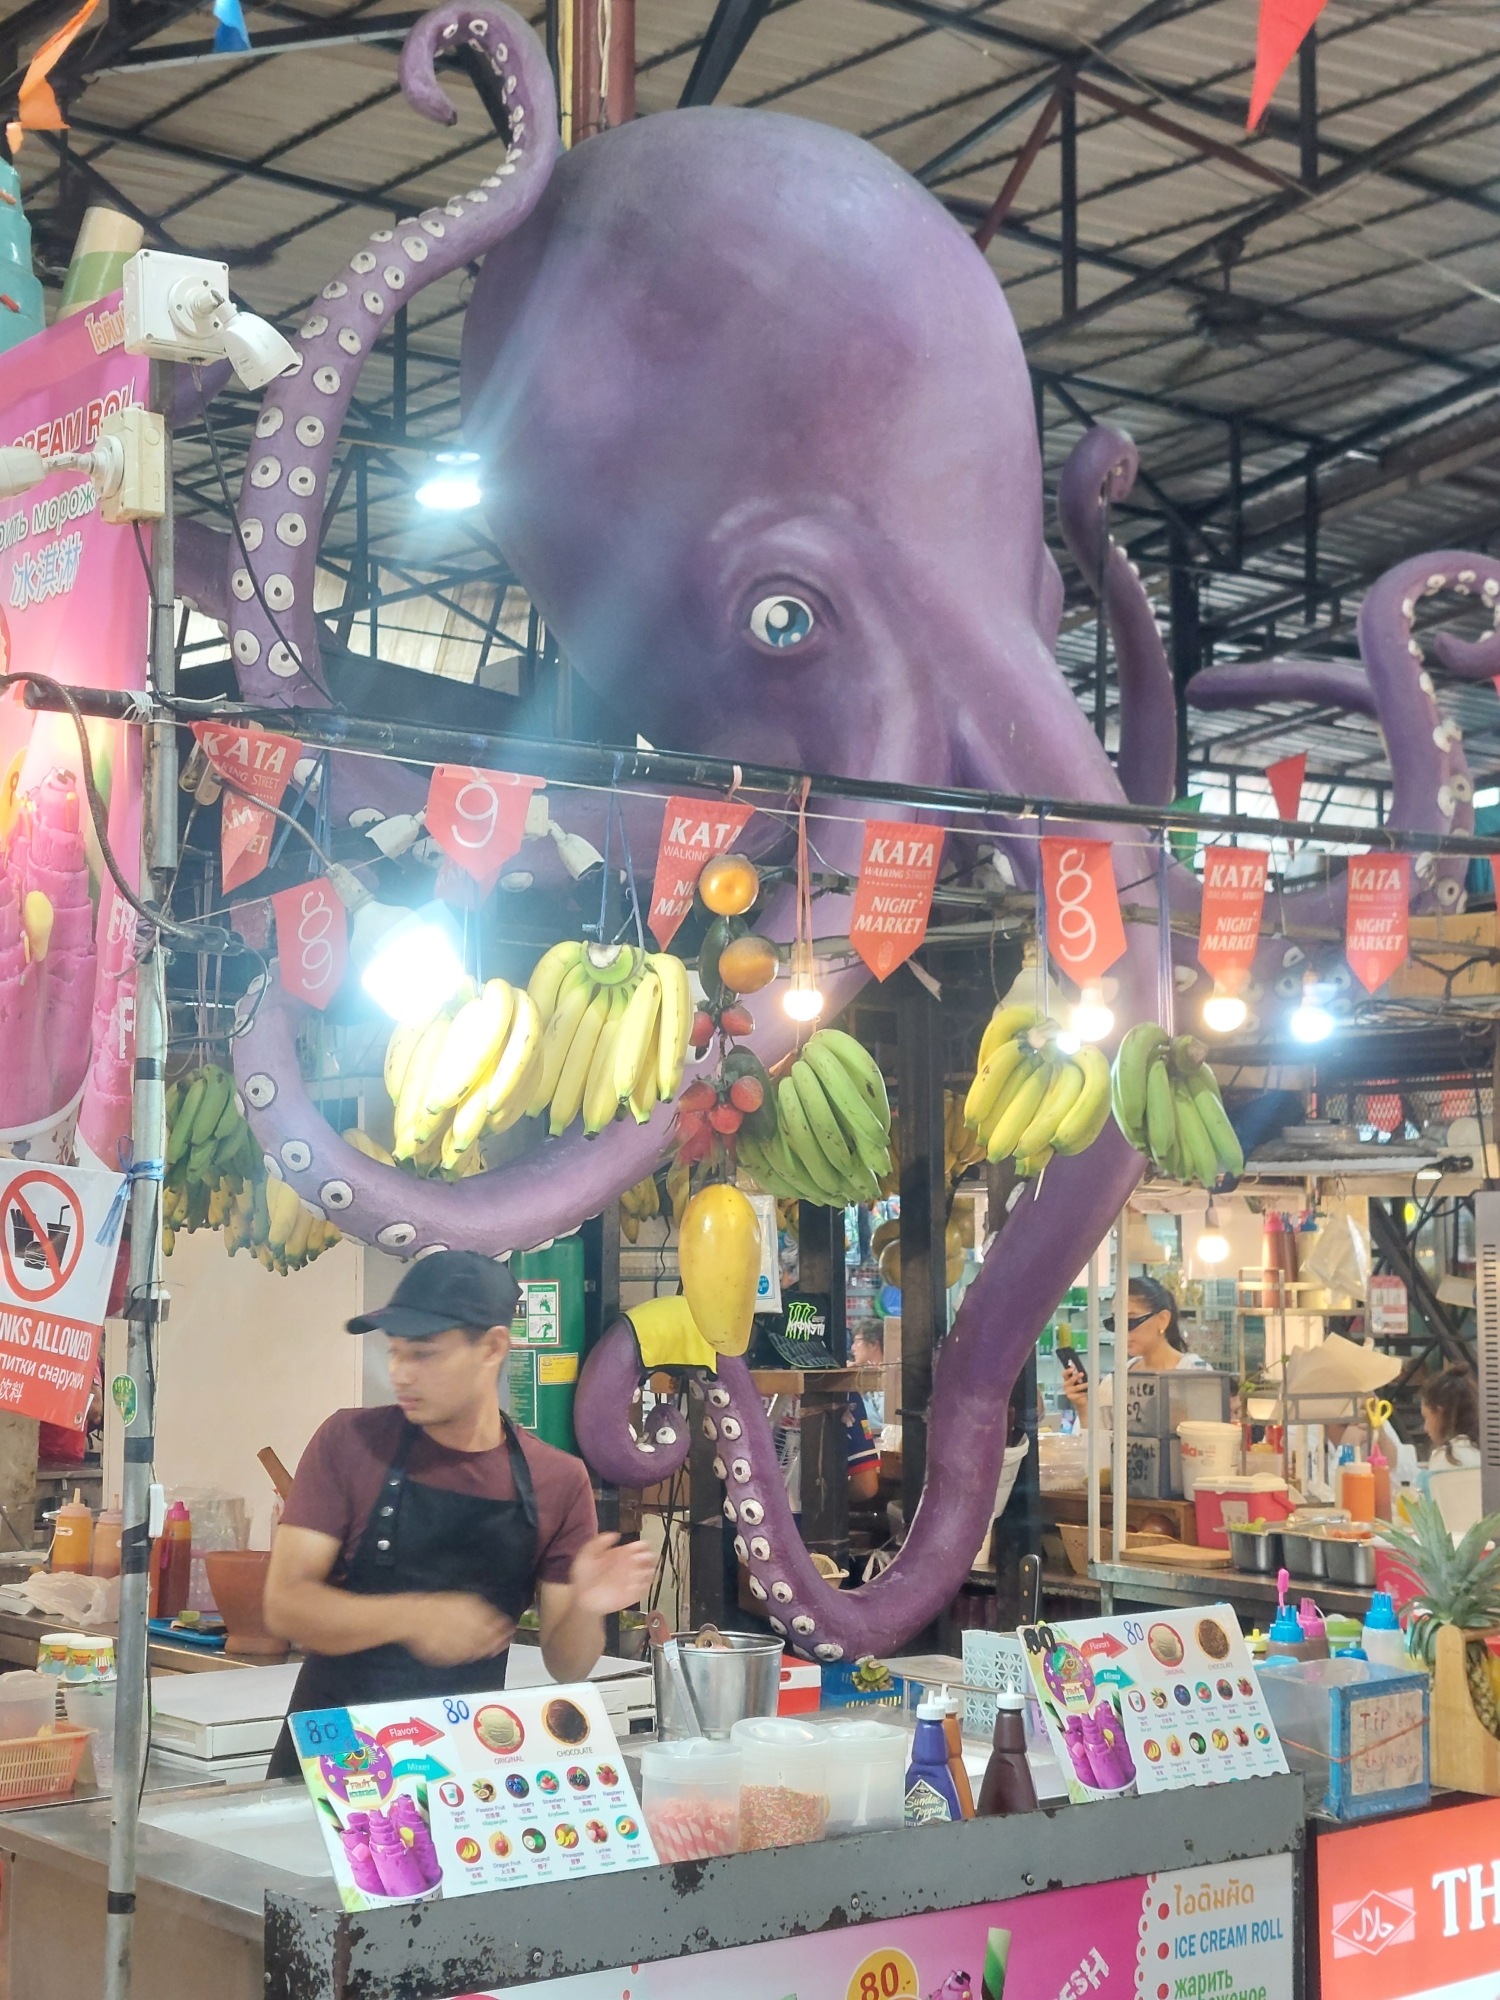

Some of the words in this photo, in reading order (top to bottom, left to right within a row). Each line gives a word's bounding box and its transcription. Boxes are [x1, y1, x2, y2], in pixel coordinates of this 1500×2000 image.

[32, 482, 98, 535] морож
[10, 532, 82, 610] 冰淇淋
[203, 732, 287, 774] KATA
[868, 838, 934, 867] KATA
[864, 866, 904, 880] WALKING
[906, 869, 933, 880] STREET
[1208, 865, 1264, 888] KATA
[1351, 868, 1401, 891] KATA
[871, 896, 918, 914] NIGHT
[854, 914, 923, 934] MARKET
[1216, 917, 1254, 933] NIGHT
[1355, 918, 1394, 933] NIGHT
[1203, 934, 1256, 951] MARKET
[1348, 935, 1403, 951] MARKET
[32, 1321, 92, 1361] ALLOWED
[38, 1363, 84, 1391] снаружи
[1123, 1620, 1144, 1645] 80
[1089, 1640, 1110, 1650] Flavors
[1164, 1668, 1186, 1676] ORIGINAL
[1208, 1662, 1234, 1671] CHOCOLATE
[443, 1699, 469, 1724] 80
[307, 1719, 338, 1743] 80
[389, 1725, 419, 1738] Flavors
[494, 1755, 524, 1765] ORIGINAL
[557, 1746, 593, 1758] CHOCOLATE
[407, 1762, 430, 1772] Mixer
[905, 1793, 941, 1808] Sundae
[914, 1801, 947, 1820] Topping
[1174, 1879, 1255, 1917] ไอติมผัด
[1352, 1905, 1395, 1942] حلال
[1174, 1934, 1196, 1959] ICE
[1200, 1924, 1247, 1954] CREAM
[1251, 1918, 1284, 1944] ROLL
[1174, 1969, 1233, 2000] жарить
